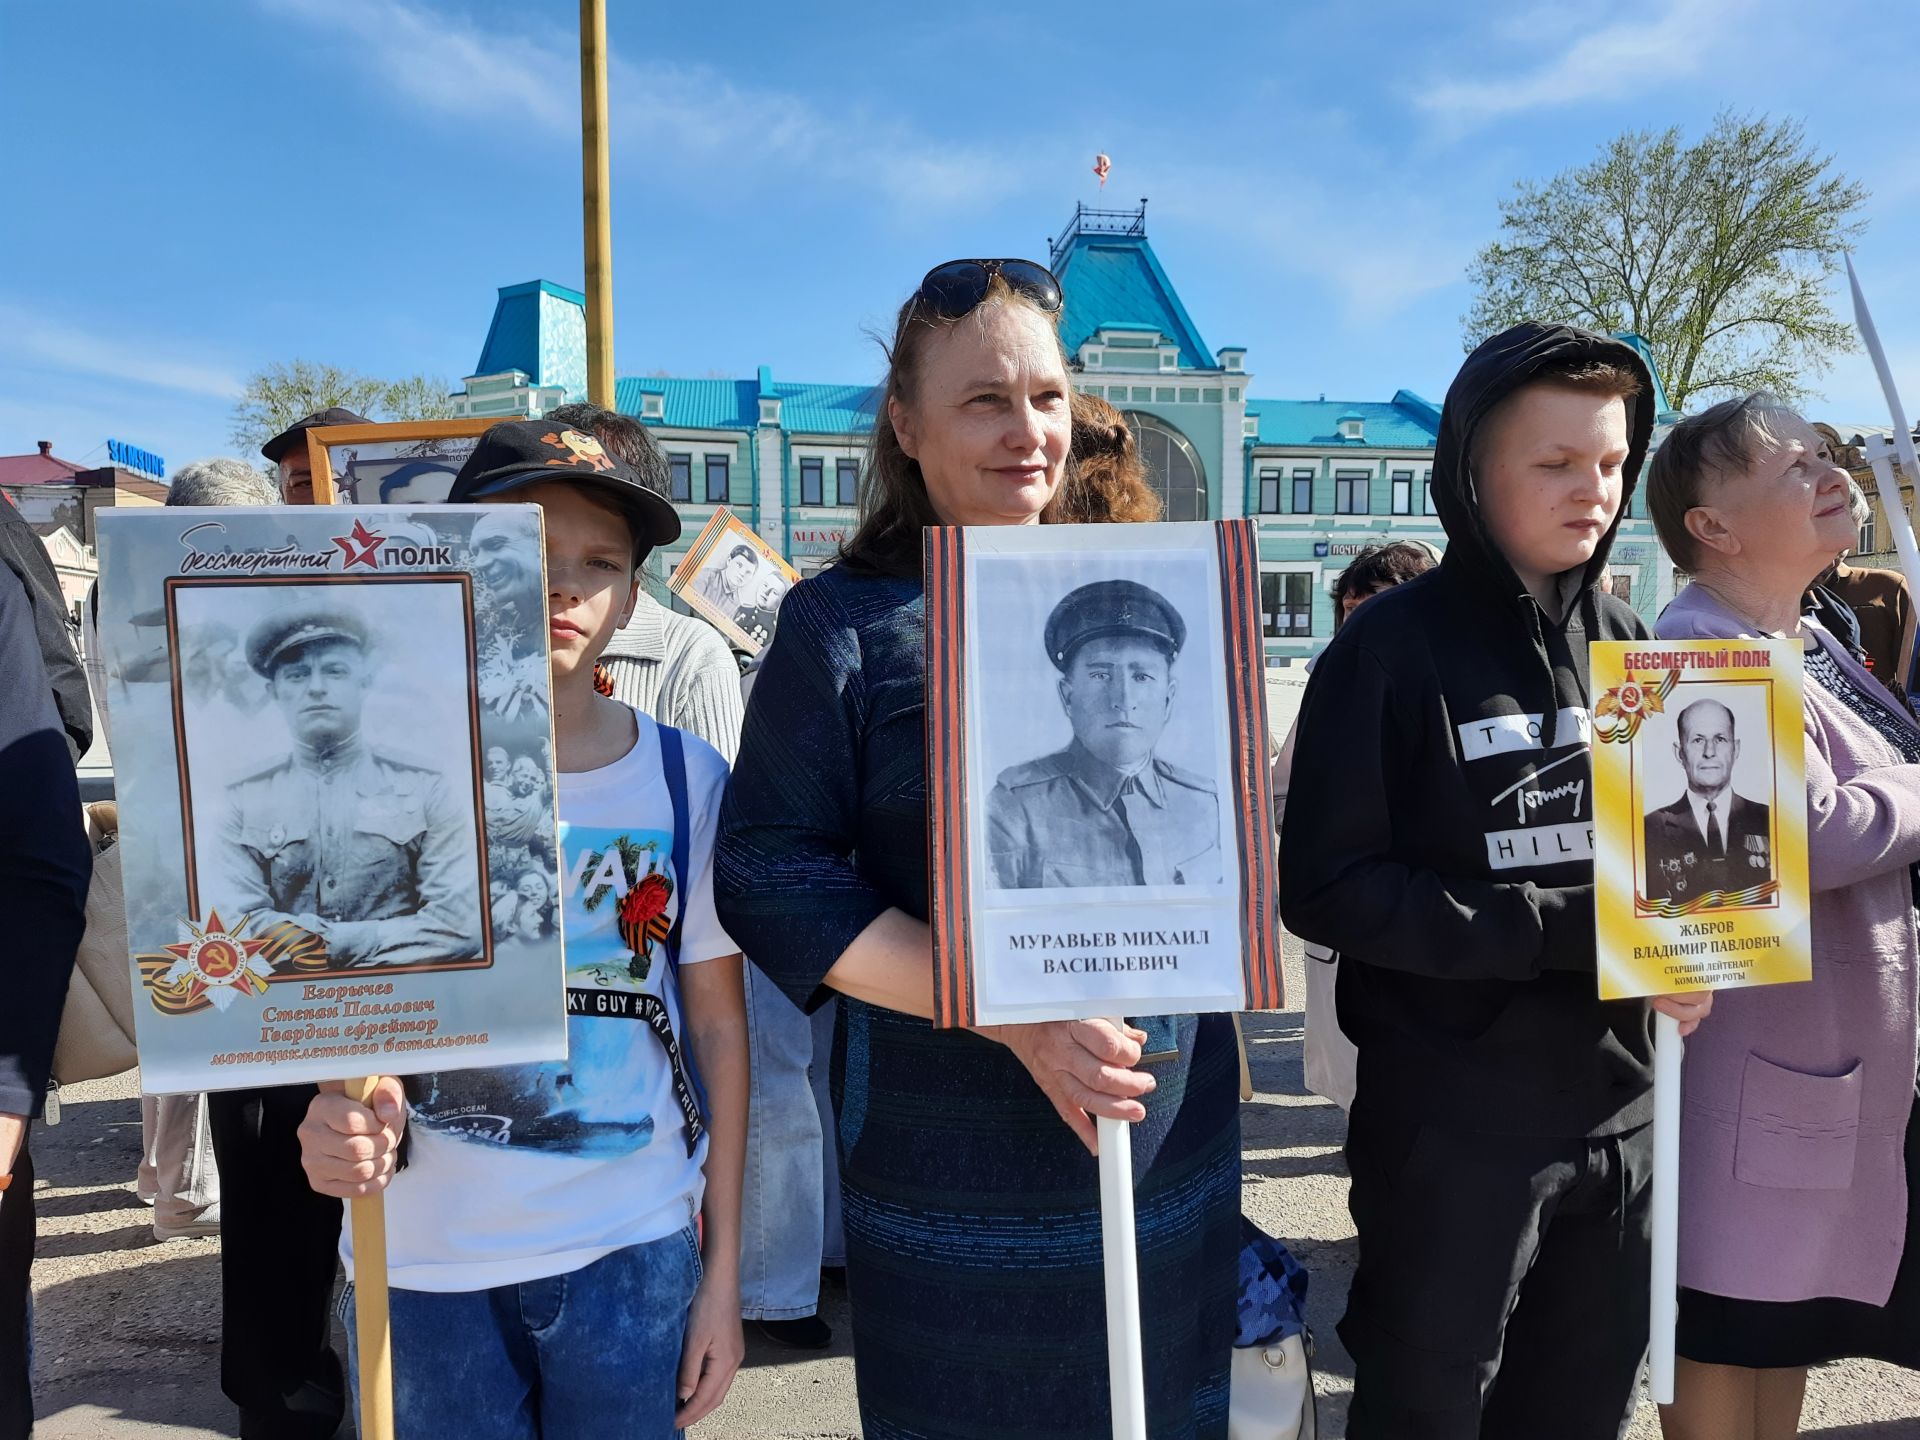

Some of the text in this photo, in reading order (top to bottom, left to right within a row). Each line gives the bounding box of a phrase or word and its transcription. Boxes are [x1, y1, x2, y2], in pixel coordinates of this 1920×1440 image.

[107, 439, 165, 478] SAMSUNG
[384, 547, 451, 566] ПОЛК
[1624, 648, 1771, 670] БЕССМЕРТНЫЙ ПОЛК
[1009, 929, 1210, 950] МУРАВЬЕВ МИХАИЛ
[1679, 921, 1734, 937] ЖАБРОВ
[1633, 936, 1781, 960] ВЛАДИМИР ПАВЛОВИЧ
[1043, 955, 1179, 974] ВАСИЛЬЕВИЧ
[1664, 959, 1755, 974] СТАРШИЙ ЛЕЙТЕНАНТ
[1674, 972, 1746, 985] КОМАНДИР РОТЫ
[303, 982, 394, 1003] Егорычев
[262, 998, 435, 1024] Степан Павлович
[597, 994, 628, 1014] GUY
[260, 1016, 439, 1045] Гвардии ефрейтор
[210, 1031, 489, 1066] мотоциклетного батальона
[460, 1104, 487, 1114] OCEAN
